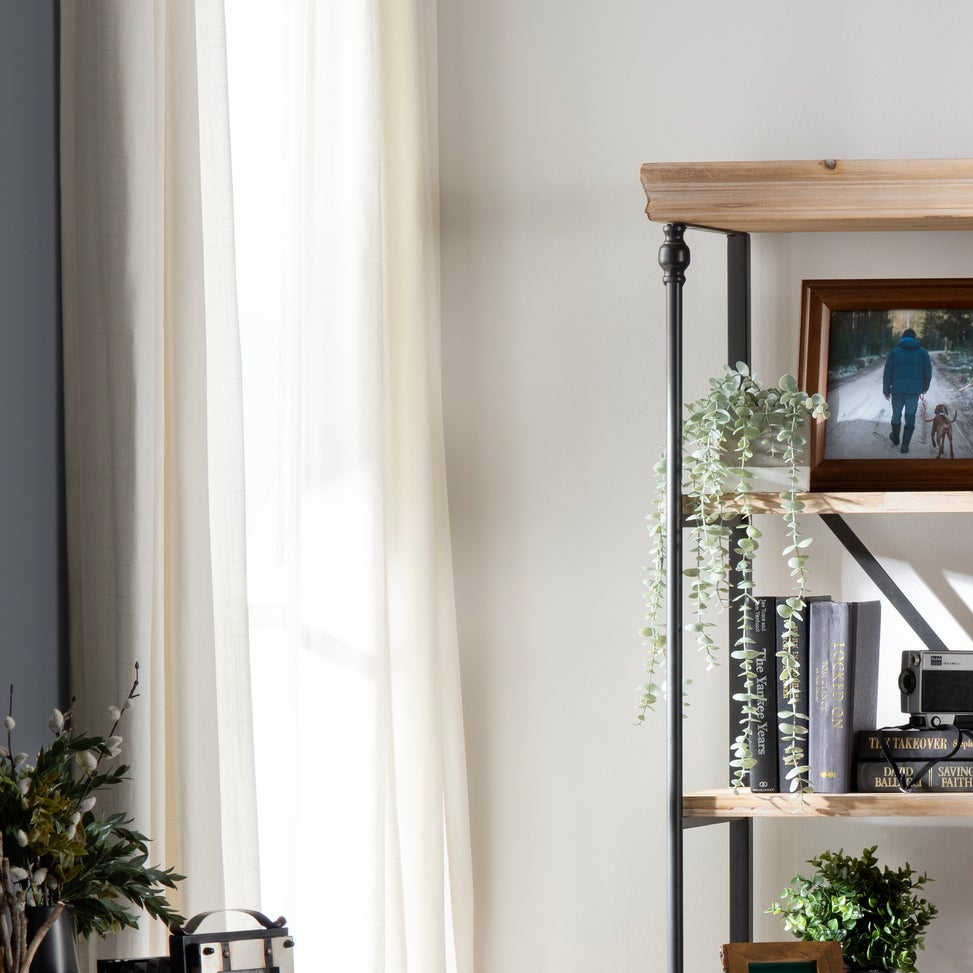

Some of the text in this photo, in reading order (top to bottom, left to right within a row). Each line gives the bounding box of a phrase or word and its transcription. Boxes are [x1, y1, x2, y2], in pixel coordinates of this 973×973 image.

[755, 648, 768, 756] The Yankee Years
[832, 642, 845, 730] LOCKED ON
[892, 738, 948, 750] TAKEOVER
[941, 778, 973, 788] FAITH
